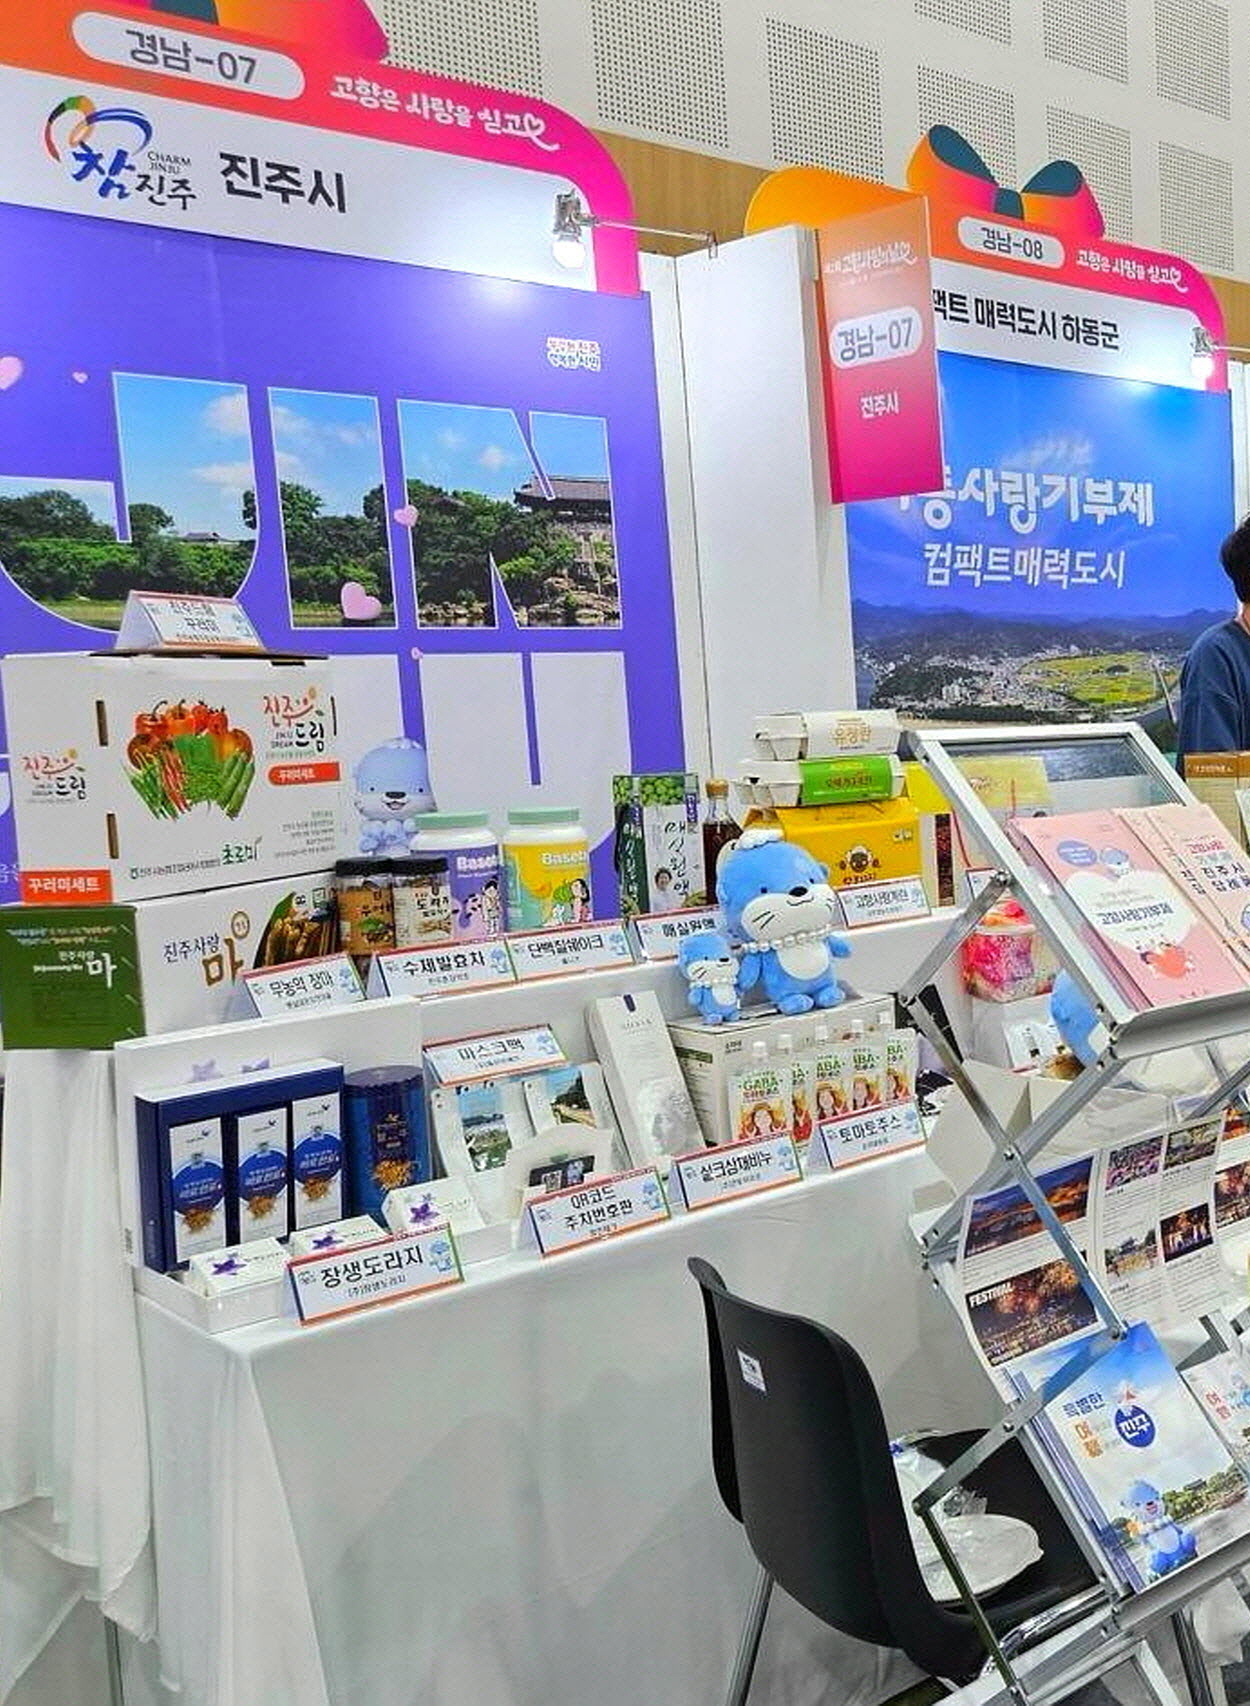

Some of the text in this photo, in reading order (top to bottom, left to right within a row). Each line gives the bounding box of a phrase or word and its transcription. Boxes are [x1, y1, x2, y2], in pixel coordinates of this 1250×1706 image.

[127, 30, 257, 85] 경남-07
[330, 76, 400, 113] 고향은
[406, 88, 474, 128] 사랑을
[147, 150, 192, 168] CHARM
[136, 173, 197, 211] 진주
[219, 151, 347, 214] 진주시
[980, 226, 1043, 261] 경남-08
[974, 297, 1058, 341] 매력도시
[1062, 313, 1120, 350] 하동군
[837, 318, 914, 362] 경남-07
[860, 390, 900, 420] 진주시
[924, 542, 1126, 590] 컴팩트매력도시
[263, 692, 313, 728] 진주
[295, 721, 325, 753] 드림
[28, 877, 102, 893] 꾸러미세트
[1201, 860, 1247, 880] 진주시
[163, 935, 243, 986] 진주사랑 마
[527, 934, 604, 960] 단백질쉐이크
[402, 950, 487, 977] 수제발효차
[457, 1037, 526, 1061] 마스크팩
[838, 1115, 902, 1144] 토마토주스
[570, 1184, 617, 1210] QR코드
[320, 1244, 424, 1289] 장생도라지
[1062, 1391, 1105, 1419] 특별한
[1118, 1413, 1151, 1440] 진주
